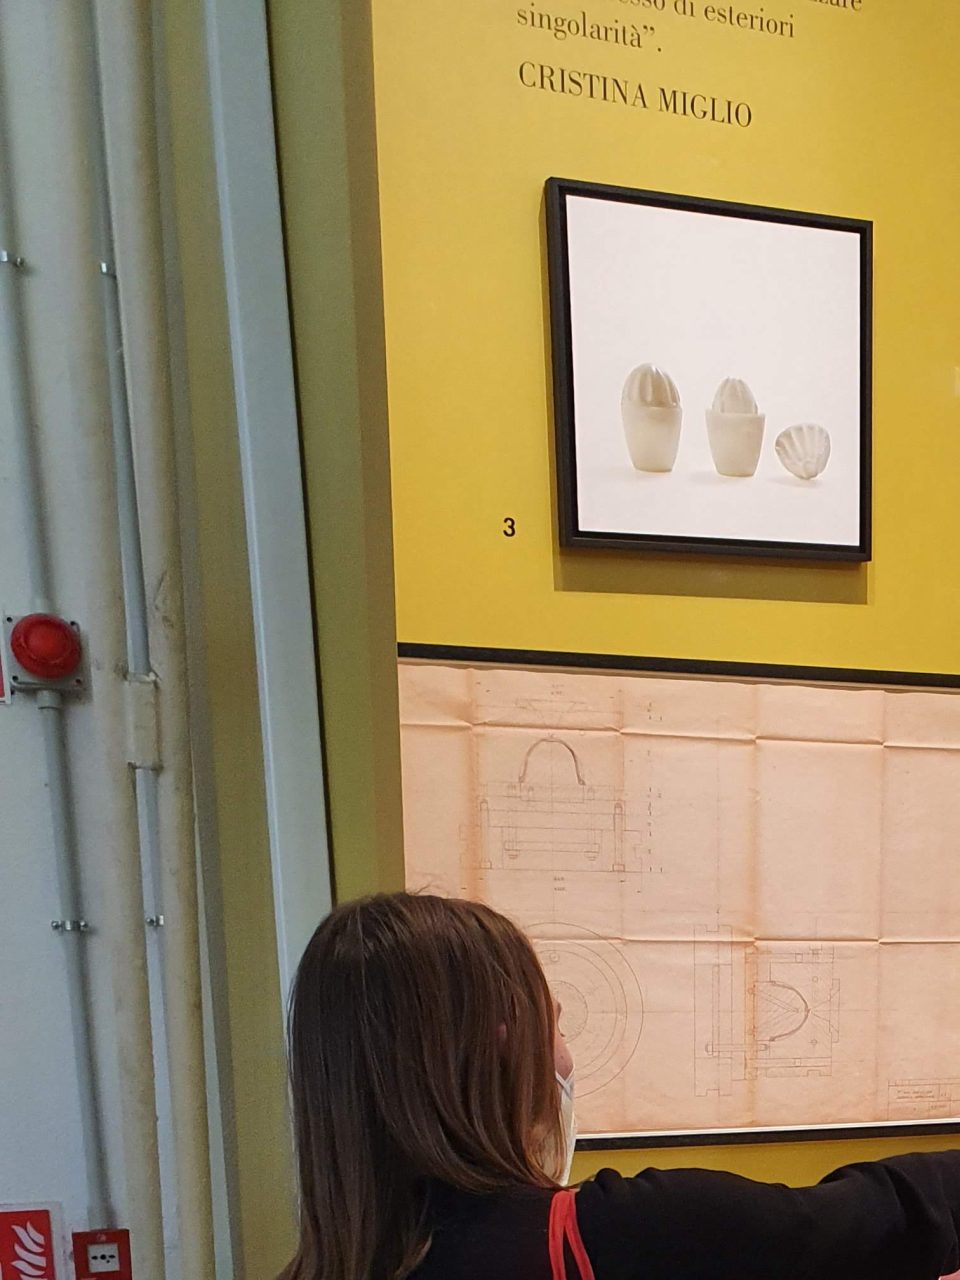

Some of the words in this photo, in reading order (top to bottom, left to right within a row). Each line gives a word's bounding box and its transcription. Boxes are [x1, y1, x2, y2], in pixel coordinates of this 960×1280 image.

[703, 4, 796, 38] esteriori
[518, 61, 649, 109] CRISTINA
[658, 87, 752, 128] MIGLIO
[503, 517, 516, 537] 3
